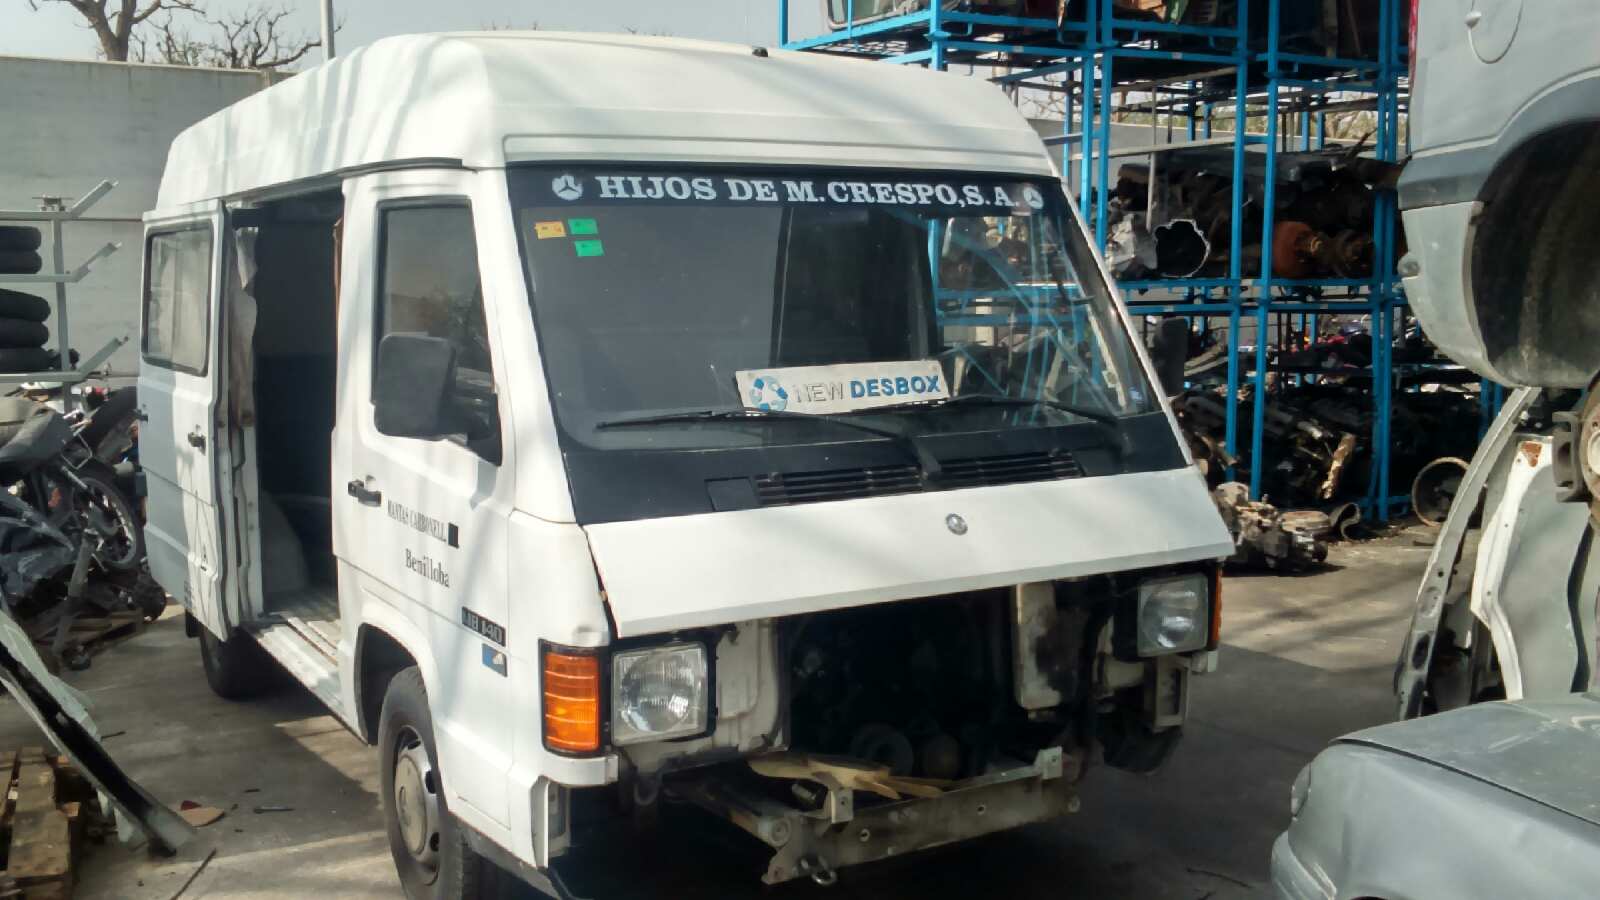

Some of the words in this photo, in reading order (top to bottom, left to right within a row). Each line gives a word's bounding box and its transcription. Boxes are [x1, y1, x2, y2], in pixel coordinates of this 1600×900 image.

[594, 175, 717, 200] HIJOS
[724, 178, 779, 202] DE
[792, 382, 844, 403] NEW
[850, 375, 941, 398] DESBOX
[405, 548, 450, 588] Benilloba
[481, 619, 504, 643] 140
